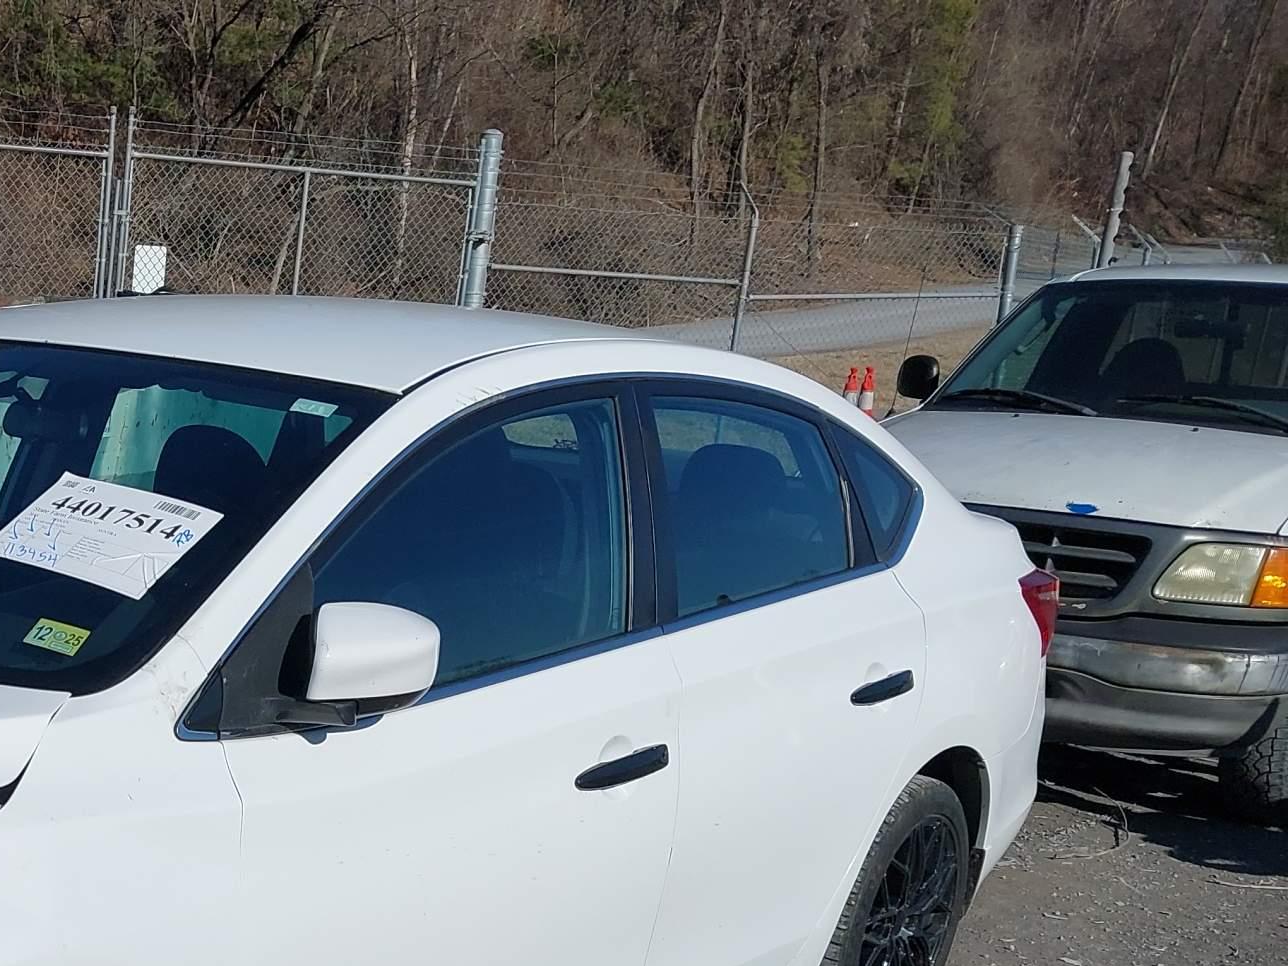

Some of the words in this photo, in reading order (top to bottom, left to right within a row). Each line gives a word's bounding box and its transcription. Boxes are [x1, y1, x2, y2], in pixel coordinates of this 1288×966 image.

[51, 496, 182, 540] 44017514
[33, 624, 54, 641] 12
[64, 633, 84, 647] 25
